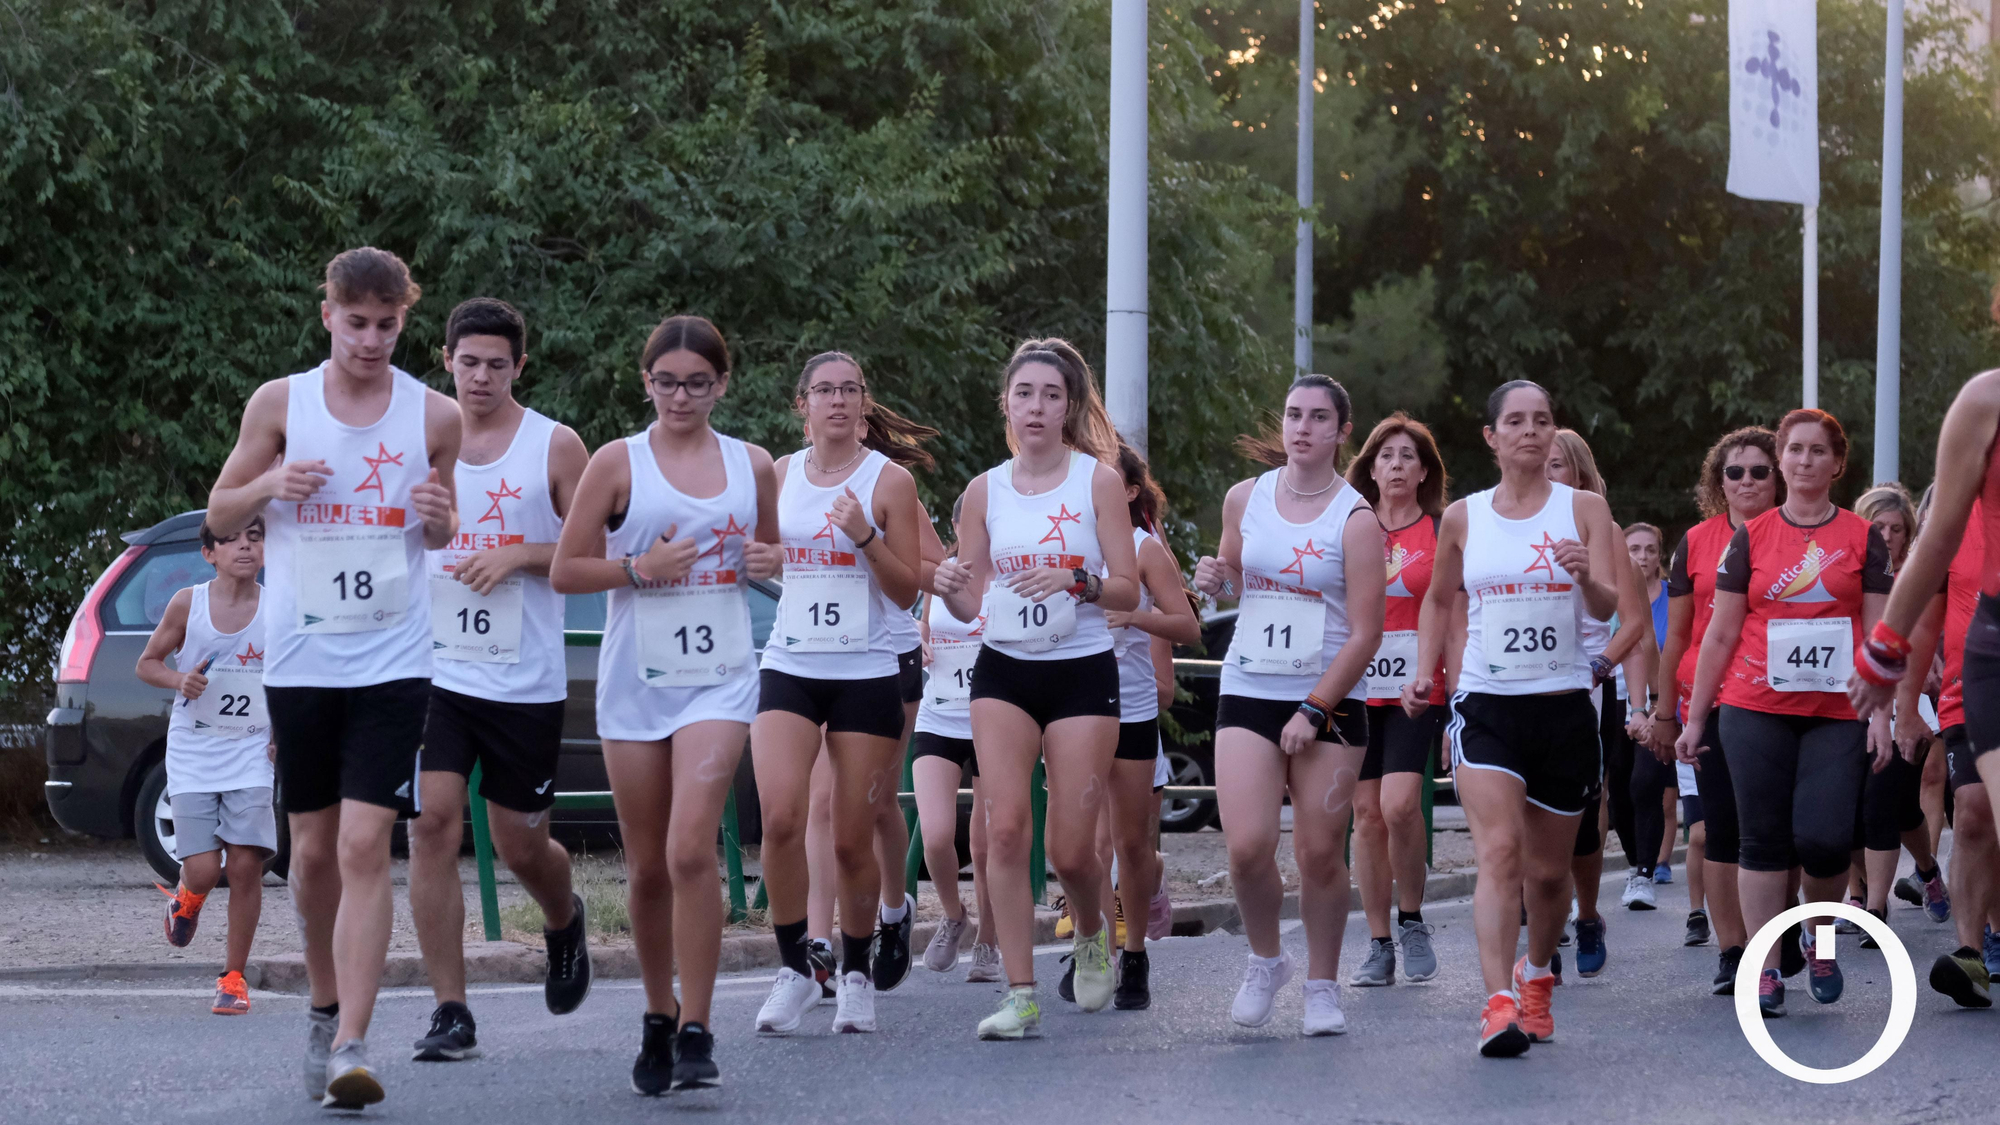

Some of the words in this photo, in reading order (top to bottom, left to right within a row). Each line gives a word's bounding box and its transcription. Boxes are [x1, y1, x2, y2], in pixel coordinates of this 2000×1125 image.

[300, 504, 378, 525] MUJER
[998, 554, 1060, 574] MUJER
[1764, 548, 1824, 600] verticalia
[333, 571, 373, 600] 18
[457, 608, 490, 635] 16
[809, 602, 840, 626] 15
[1018, 604, 1048, 628] 10
[674, 625, 714, 655] 13
[1264, 624, 1291, 649] 11
[1504, 626, 1557, 653] 236
[1787, 646, 1835, 668] 447
[219, 694, 250, 716] 22
